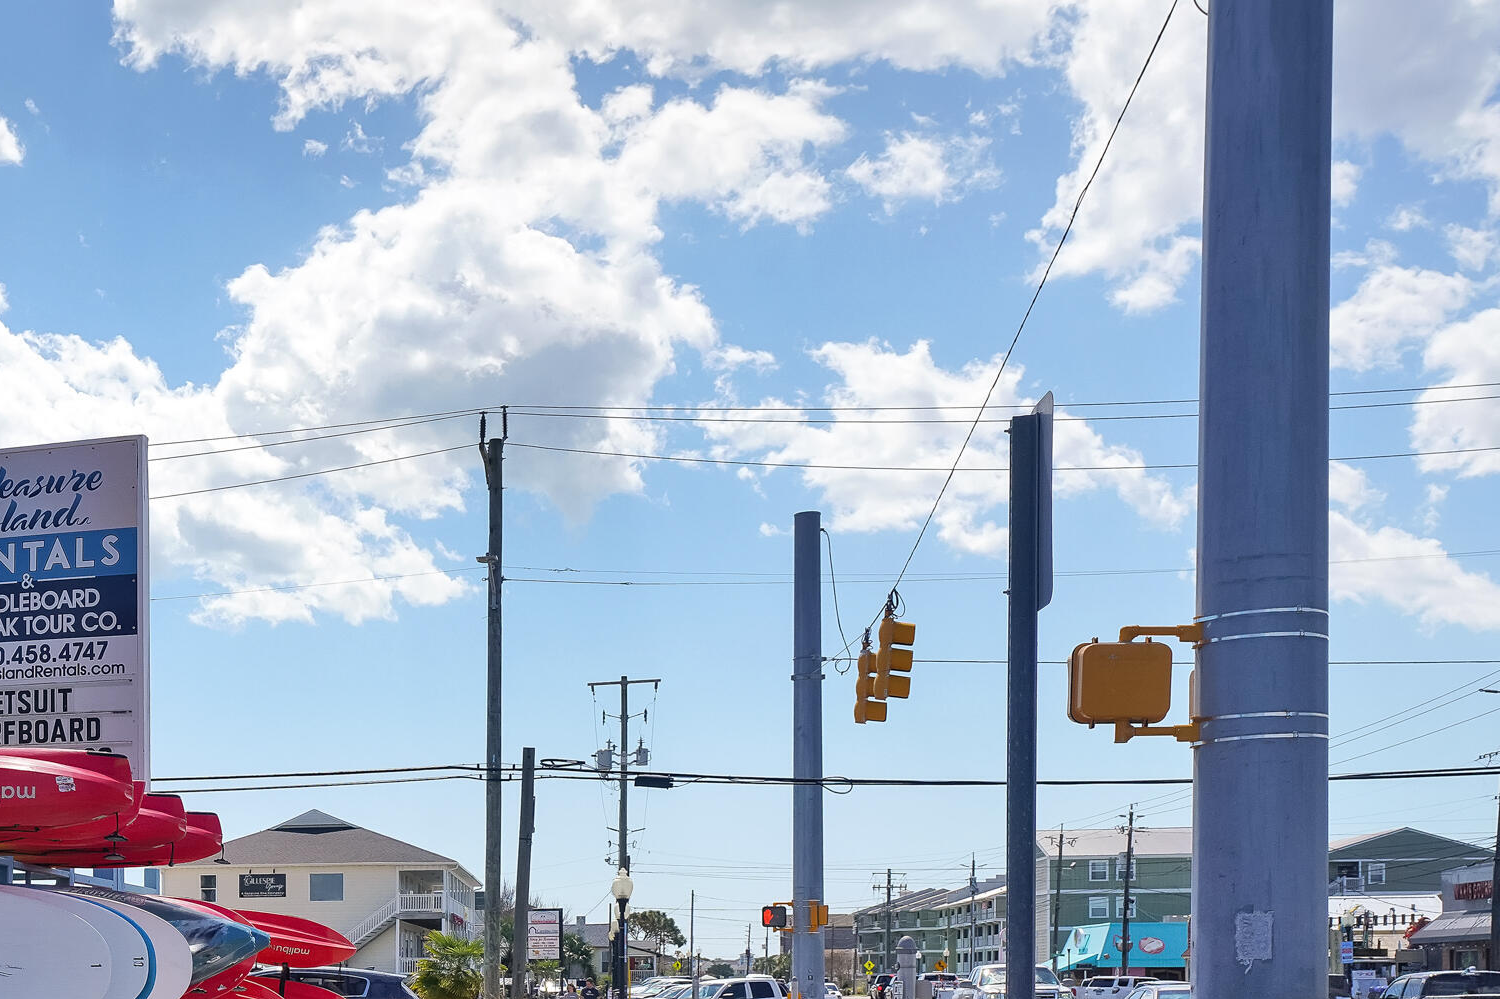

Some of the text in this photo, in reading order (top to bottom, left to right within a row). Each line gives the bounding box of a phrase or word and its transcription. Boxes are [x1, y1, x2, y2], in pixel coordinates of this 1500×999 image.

[21, 573, 34, 589] &
[24, 612, 75, 635] TOUR
[81, 611, 122, 632] CO.
[276, 945, 310, 955] malibu
